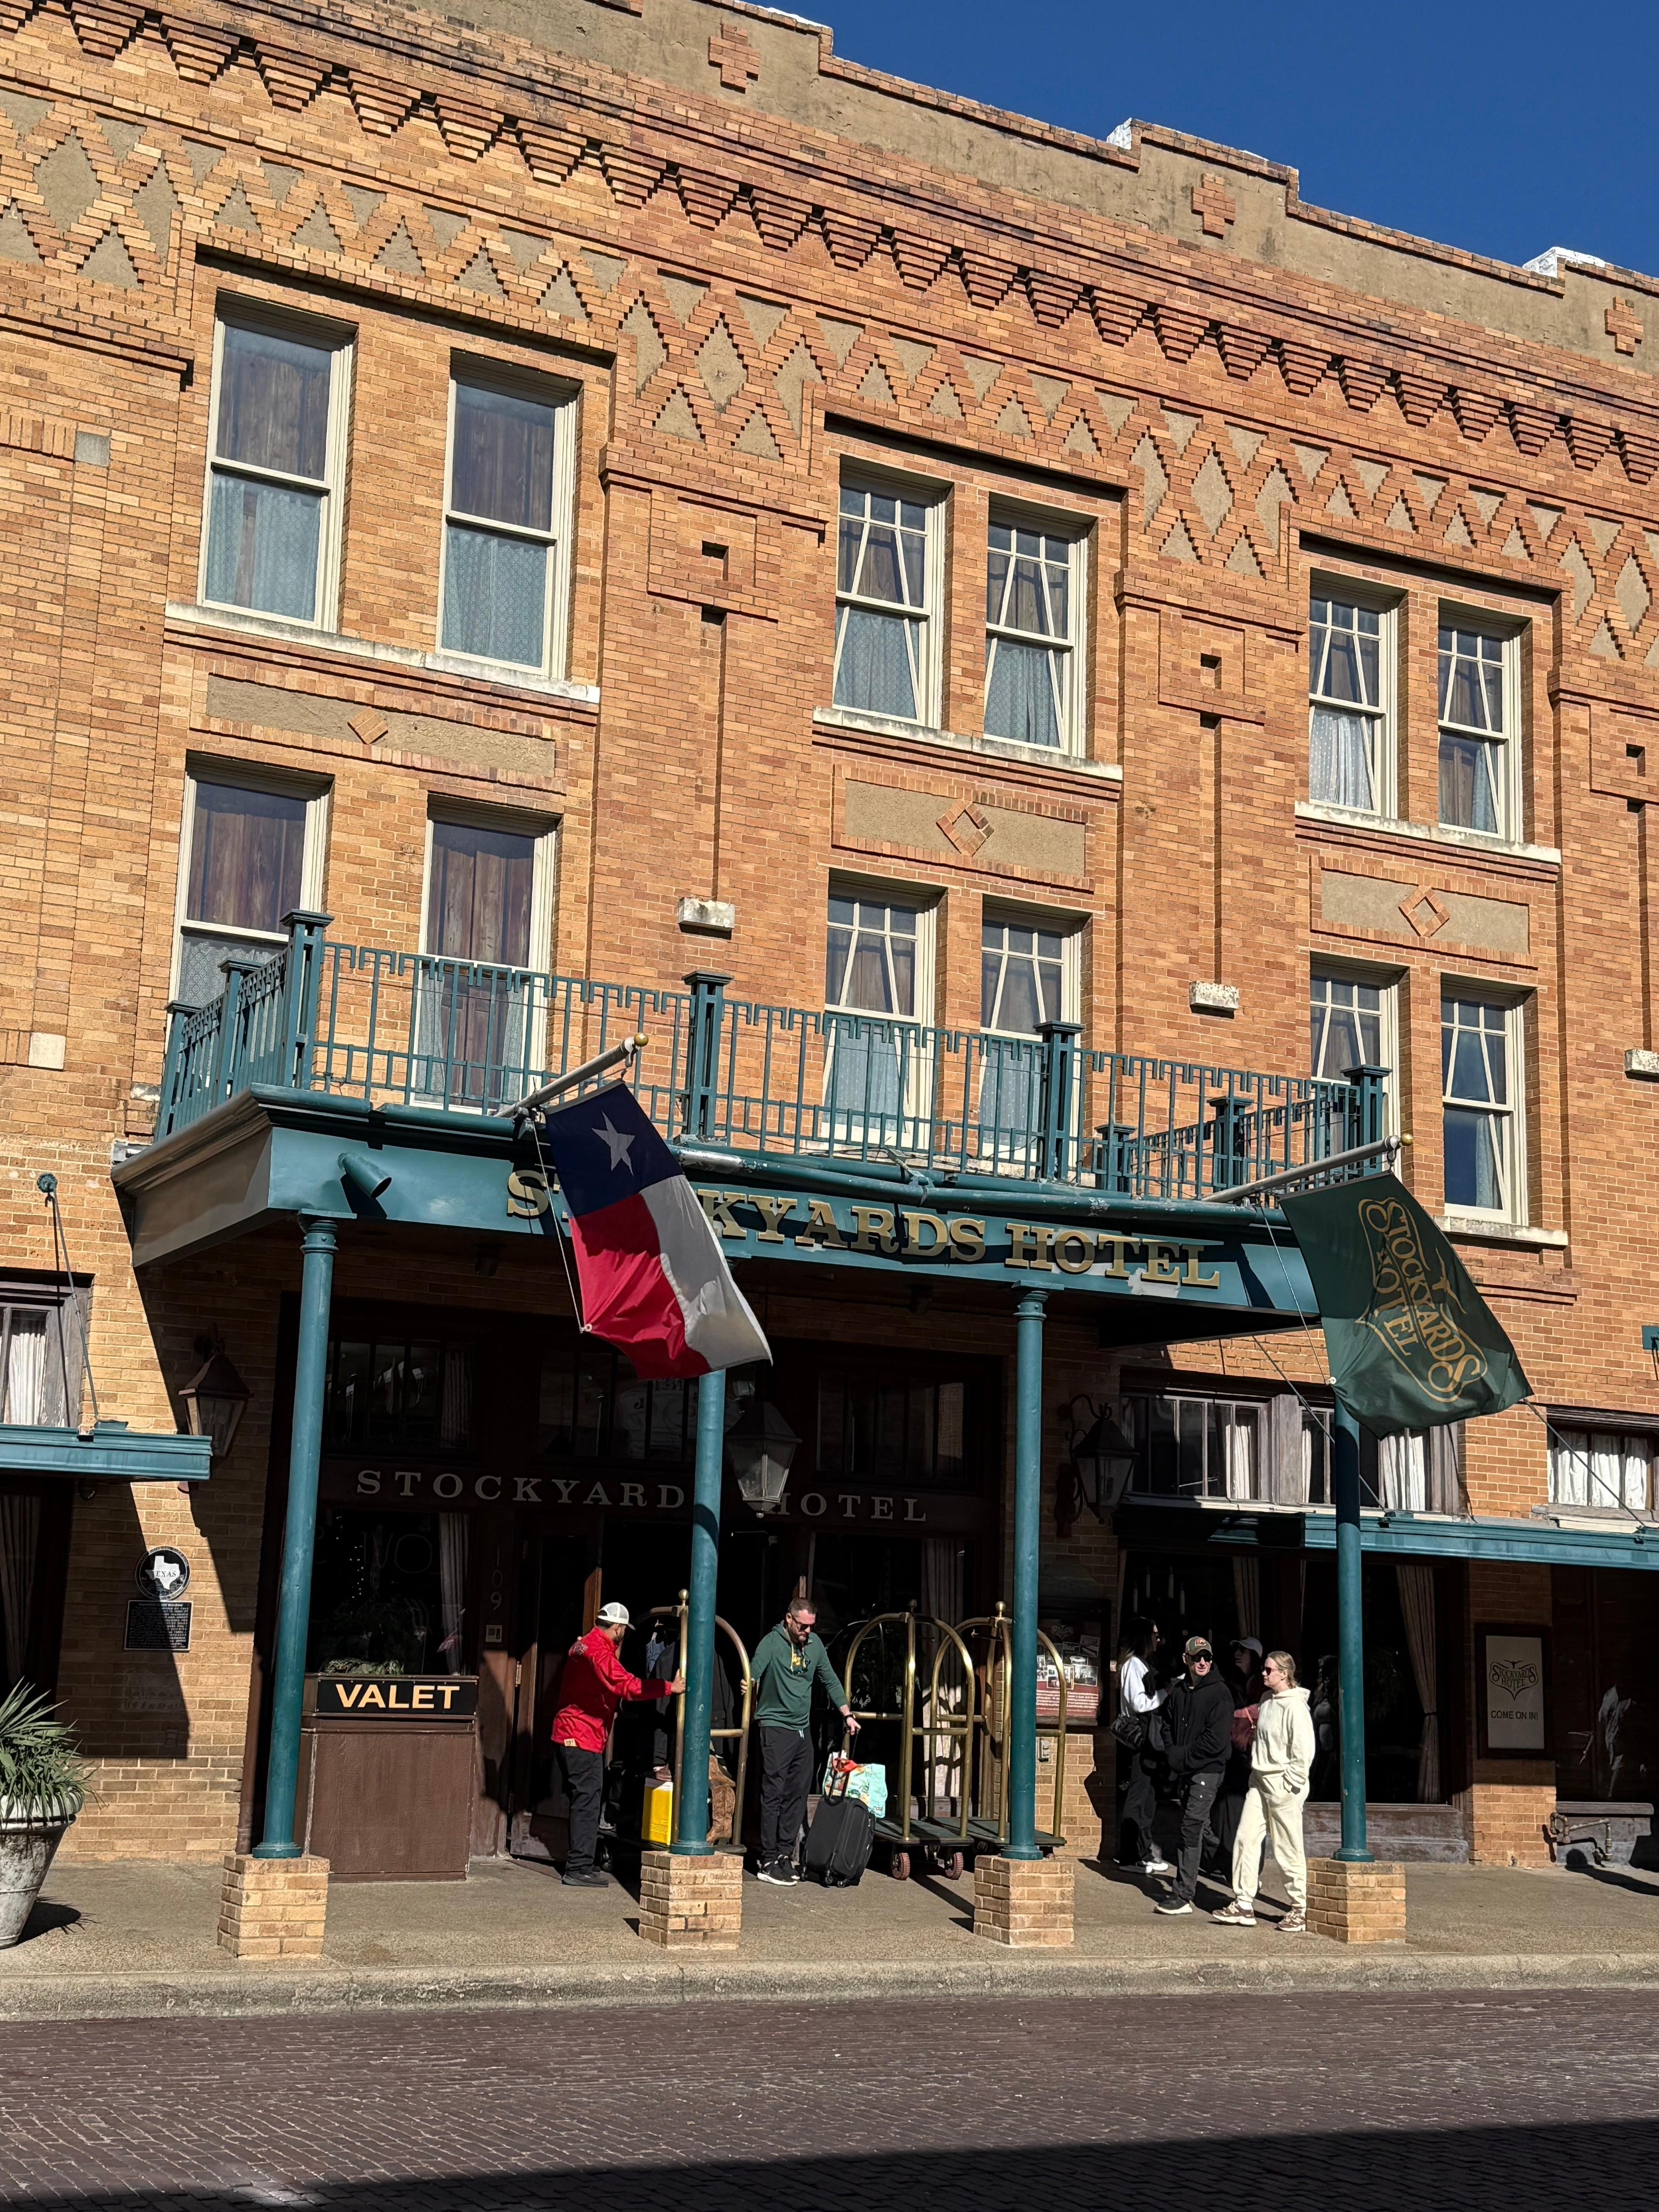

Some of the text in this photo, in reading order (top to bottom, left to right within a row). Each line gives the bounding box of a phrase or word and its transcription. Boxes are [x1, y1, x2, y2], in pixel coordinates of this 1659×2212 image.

[507, 1170, 1219, 1288] SKYARDS HOTEL
[1365, 1201, 1480, 1393] STOCKYARDS
[1374, 1247, 1419, 1356] HOTEL
[357, 1469, 685, 1508] STOCKYARD
[335, 1684, 460, 1709] VALET
[1491, 1711, 1513, 1719] COME
[1515, 1711, 1527, 1719] ON
